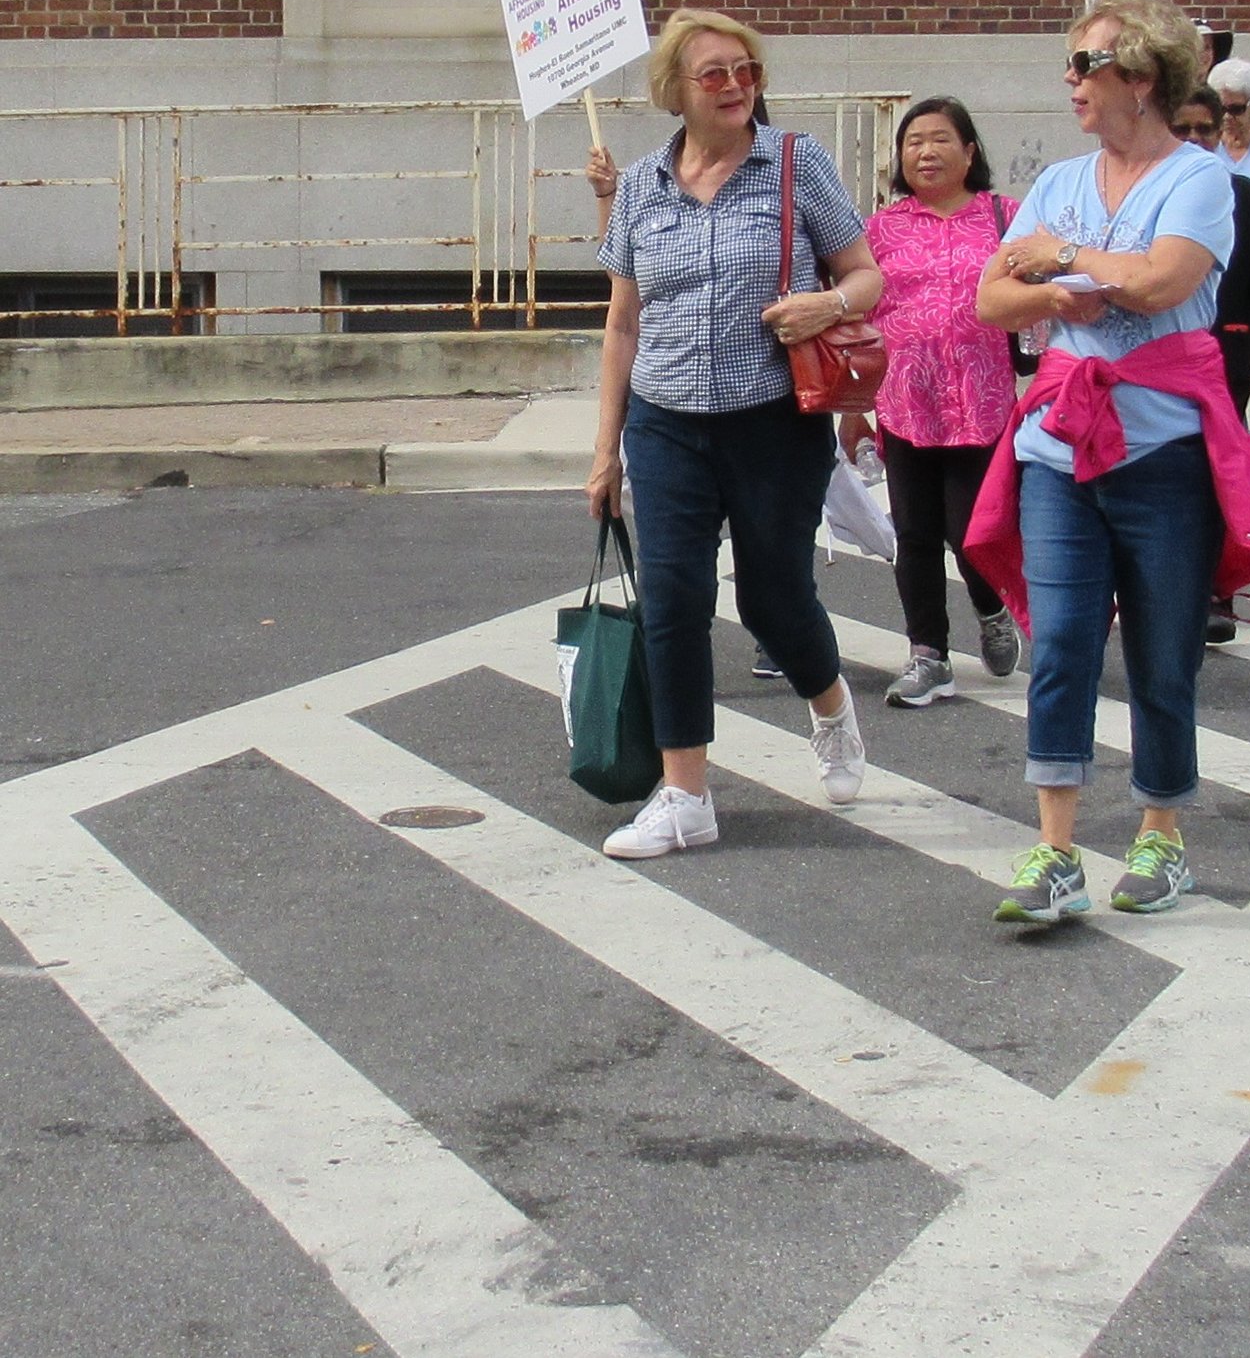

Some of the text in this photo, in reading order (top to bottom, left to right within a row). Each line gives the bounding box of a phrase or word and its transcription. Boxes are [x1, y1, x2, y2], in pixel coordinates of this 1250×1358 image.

[547, 40, 615, 84] 10700 Georgia Avenue
[558, 50, 575, 65] Buen
[610, 16, 628, 31] UMC
[589, 61, 600, 73] MD
